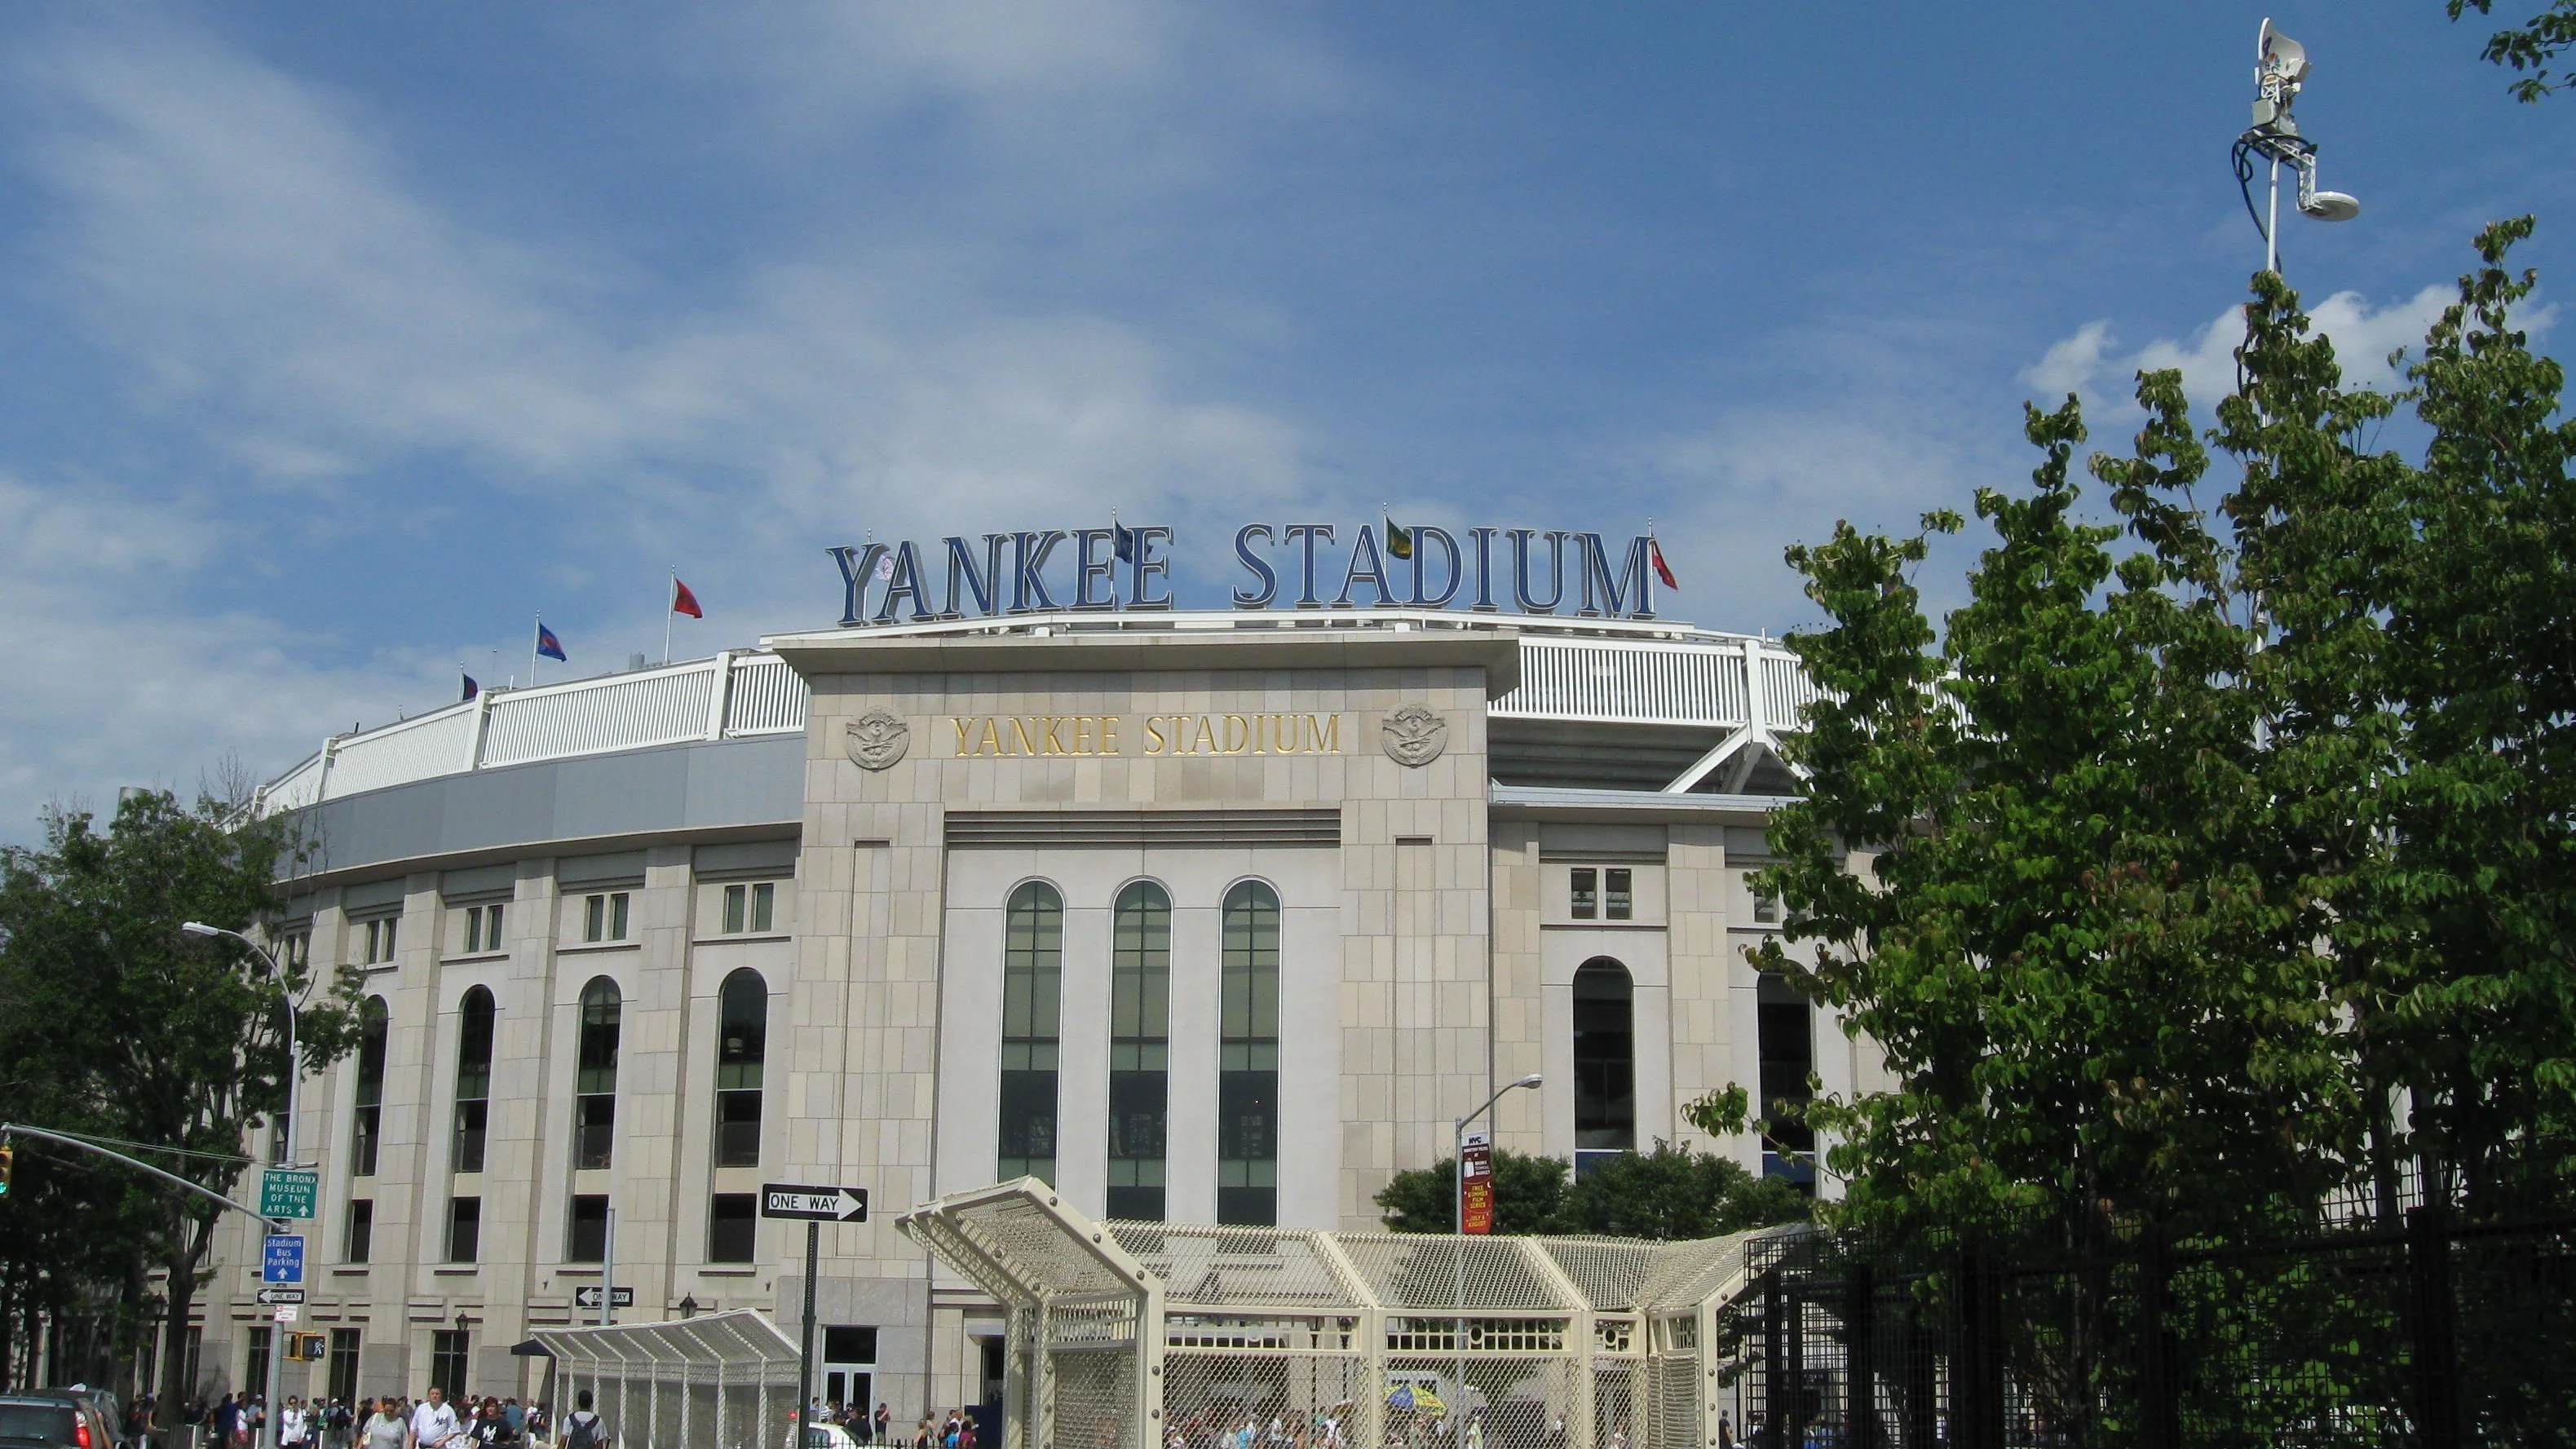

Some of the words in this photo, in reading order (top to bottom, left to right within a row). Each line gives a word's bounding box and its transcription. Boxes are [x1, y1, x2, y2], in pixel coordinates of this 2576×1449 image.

[825, 525, 1174, 627] YANKEE
[1232, 522, 1658, 620] STADIUM
[950, 716, 1120, 757] YANKEE
[1144, 714, 1341, 756] STADIUM
[265, 1173, 281, 1182] THE
[286, 1174, 316, 1184] BRONX
[269, 1183, 311, 1194] MUSEUM
[271, 1194, 284, 1202] OF
[289, 1195, 307, 1204] THE
[771, 1194, 799, 1208] ONE
[809, 1196, 839, 1211] WAY
[266, 1205, 293, 1214] ARTS
[267, 1239, 302, 1248] Stadium
[276, 1248, 292, 1257] Bus
[267, 1257, 300, 1268] Parking
